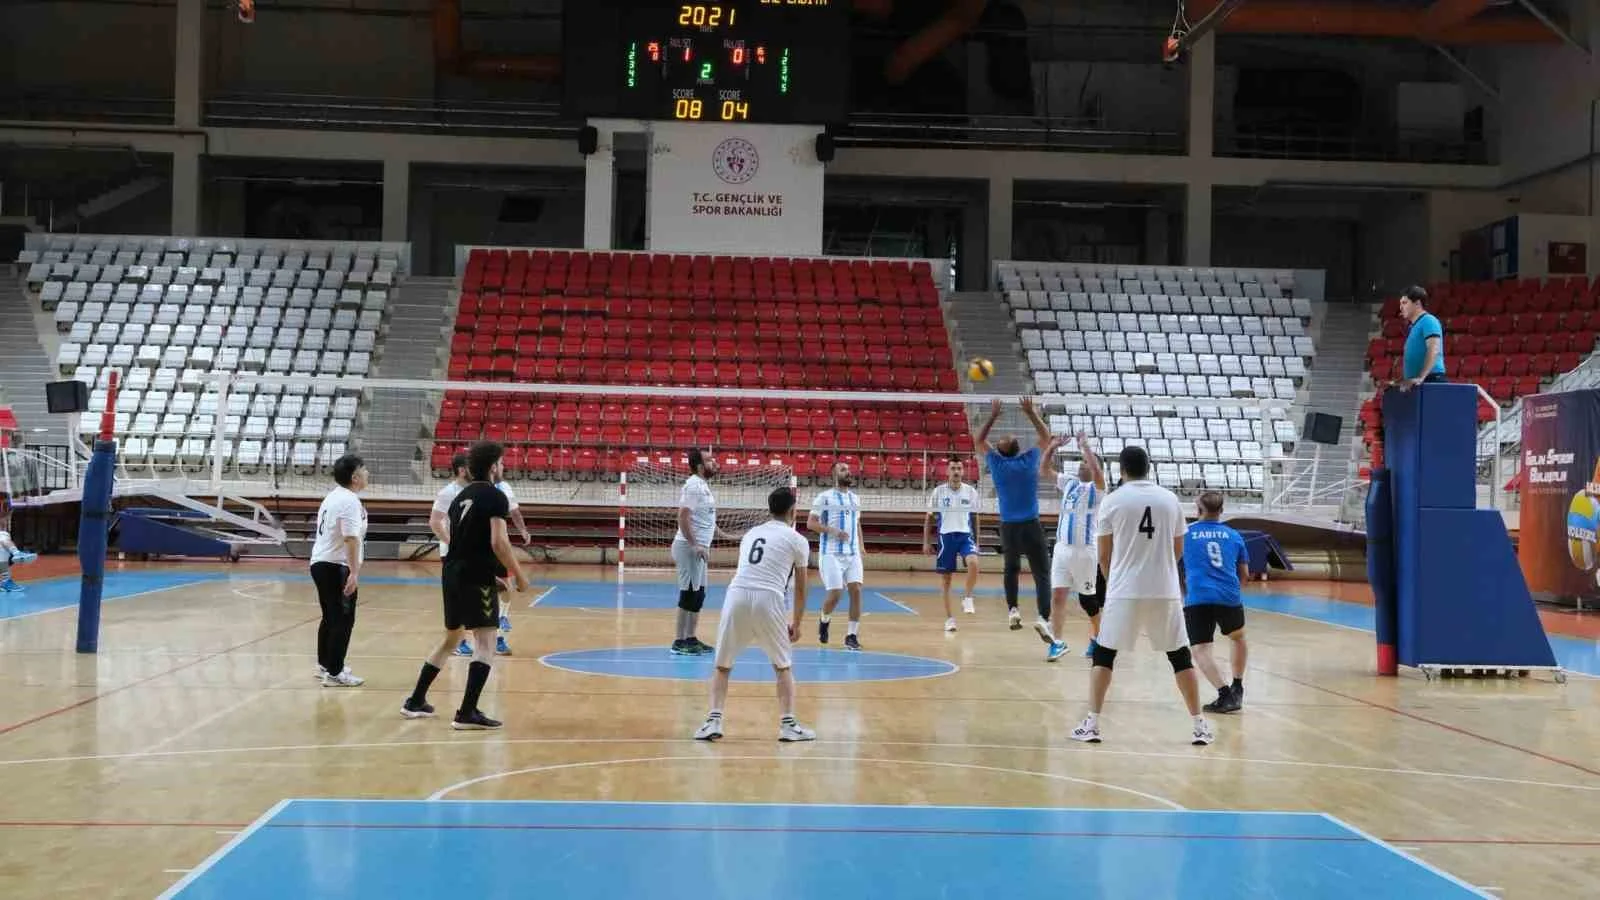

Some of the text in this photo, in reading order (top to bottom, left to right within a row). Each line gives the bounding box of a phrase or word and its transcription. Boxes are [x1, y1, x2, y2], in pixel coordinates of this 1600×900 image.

[679, 6, 735, 25] 2021
[684, 47, 690, 61] 1
[733, 48, 743, 64] 0
[701, 63, 712, 79] 2
[672, 89, 694, 99] SCORE
[719, 90, 741, 100] SCORE
[676, 100, 702, 119] 08
[722, 101, 748, 120] 04
[693, 192, 782, 204] T.C. GENÇLİK VE
[692, 205, 782, 217] SPOR BAKANLIĞI
[459, 499, 473, 523] 7
[1138, 506, 1155, 539] 4
[1191, 531, 1229, 539] ZABITA
[748, 538, 766, 565] 6
[1207, 542, 1223, 567] 9
